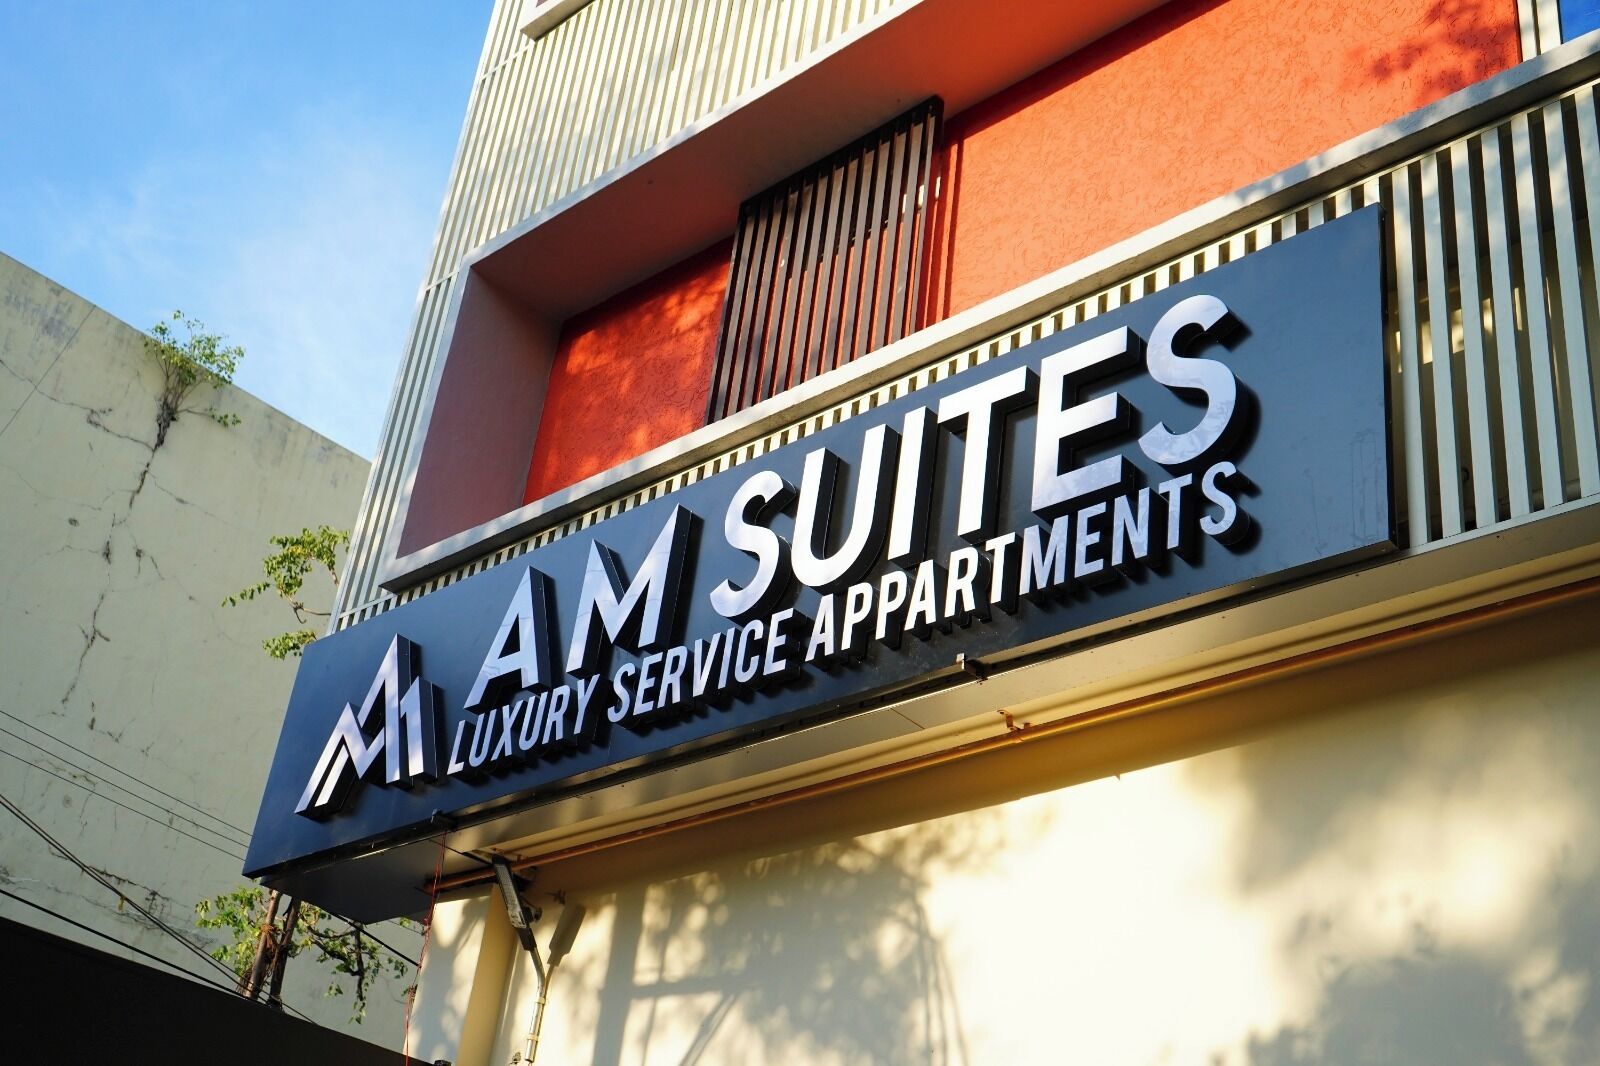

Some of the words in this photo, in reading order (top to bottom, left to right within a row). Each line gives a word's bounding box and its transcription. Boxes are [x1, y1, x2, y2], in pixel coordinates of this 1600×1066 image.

[710, 294, 1238, 618] SUITES
[447, 674, 600, 775] LUXURY
[607, 608, 795, 723] SERVICE
[805, 461, 1239, 661] APPARTMENTS
